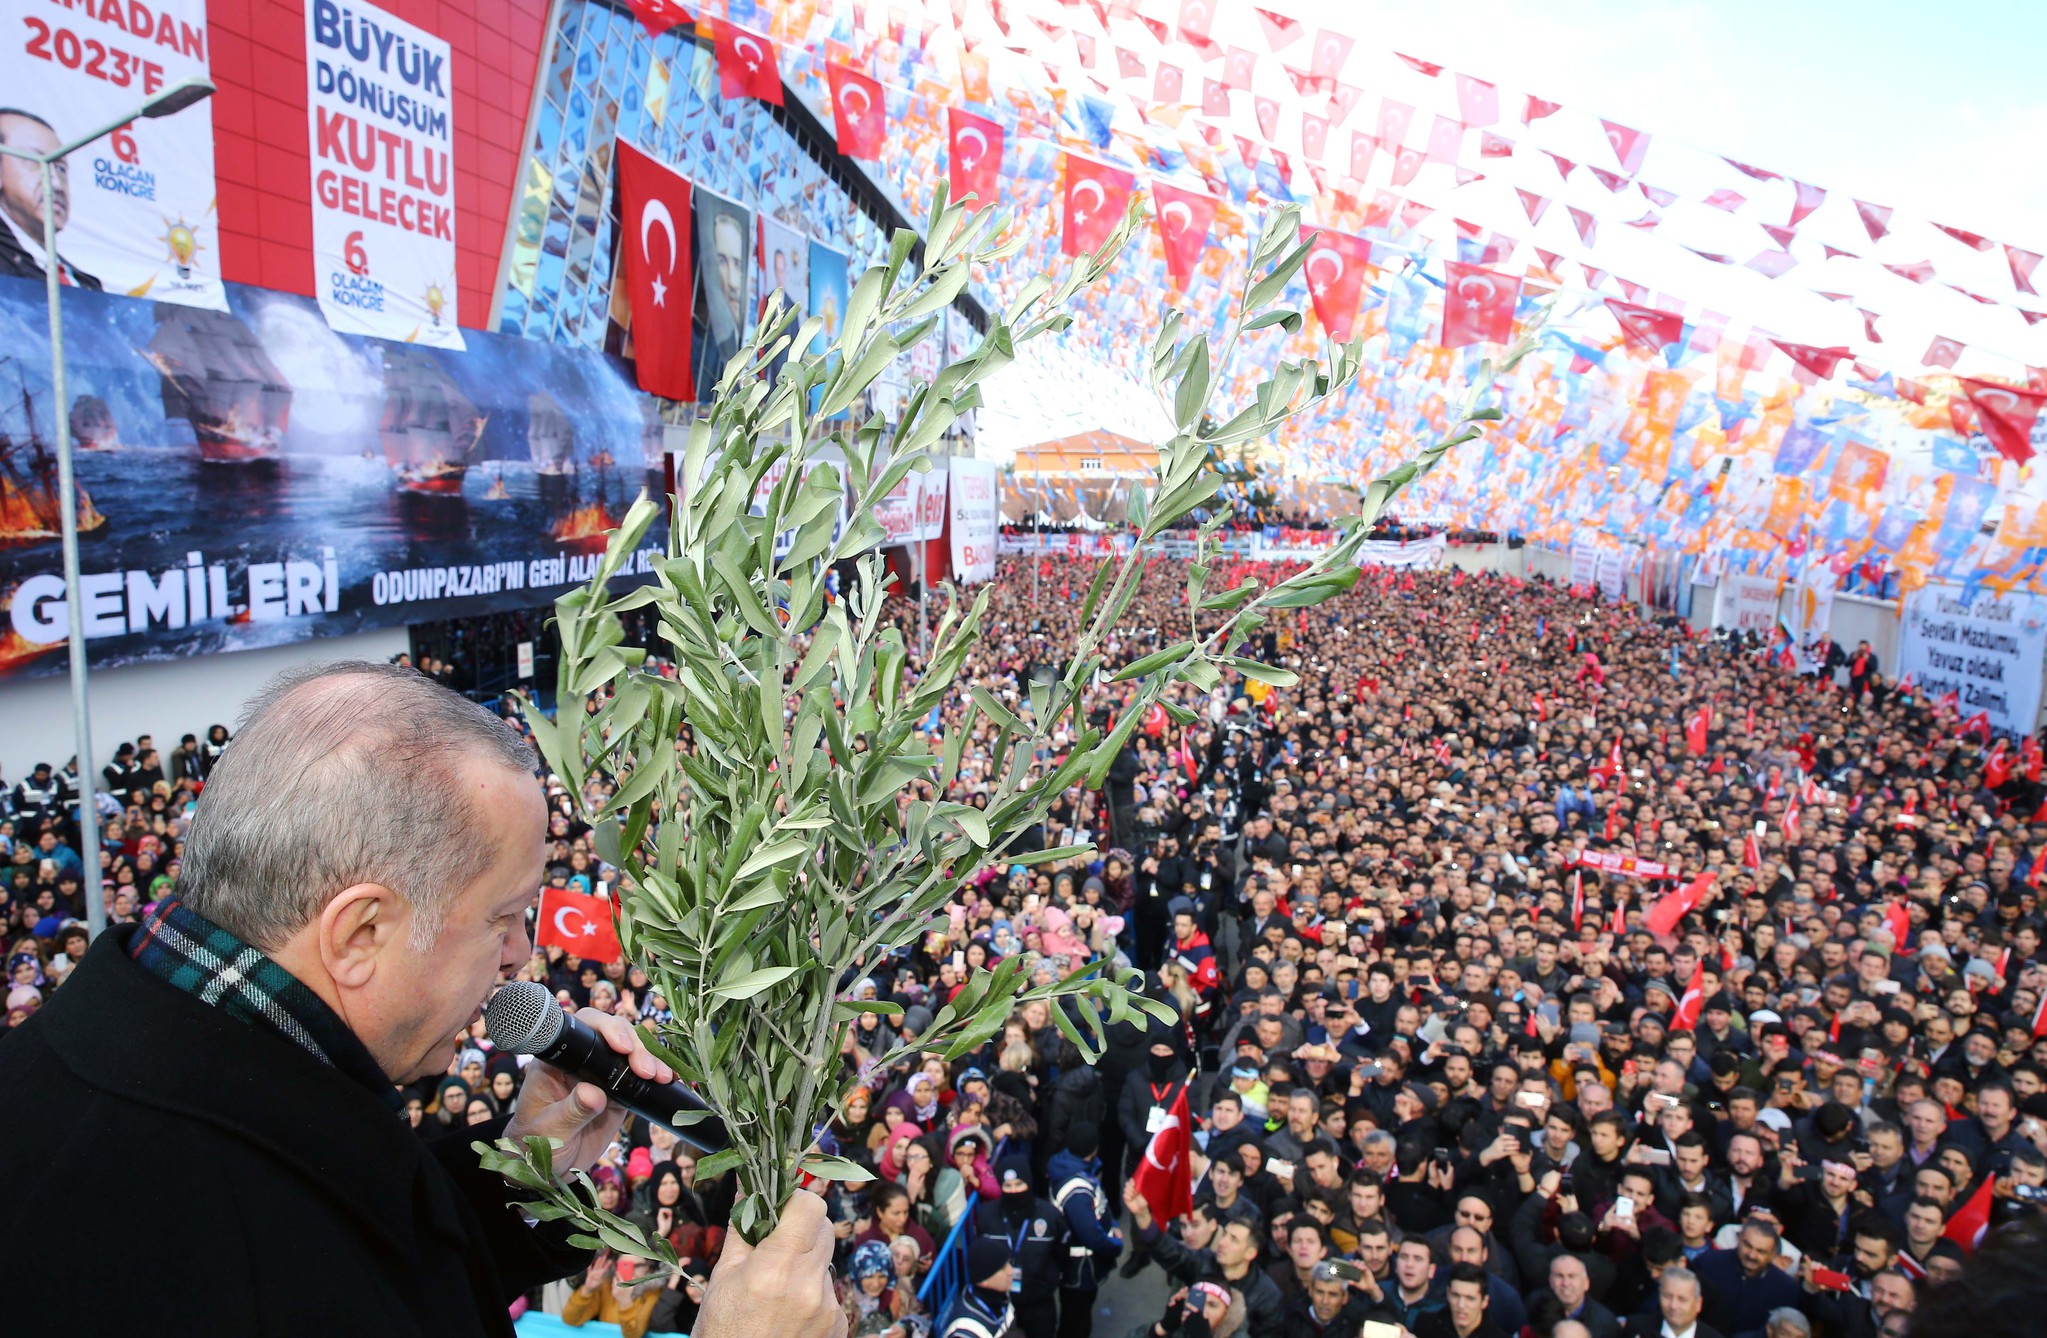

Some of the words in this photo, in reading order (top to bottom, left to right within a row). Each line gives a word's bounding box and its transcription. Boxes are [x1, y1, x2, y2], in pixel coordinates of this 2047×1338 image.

[23, 16, 163, 95] 2023'E
[50, 0, 204, 62] ADAN
[314, 0, 446, 98] BÜYÜK
[316, 58, 447, 141] DÖNÜŞÜM
[95, 173, 157, 202] KONGRE
[317, 104, 447, 197] KUTLU
[316, 169, 452, 242] GELECEK
[10, 546, 340, 645] GEMİLERİ
[372, 561, 524, 606] ODUNPAZARI'NI
[528, 551, 565, 588] GERİ
[1928, 646, 1963, 673] Yavuz
[1966, 654, 2004, 683] olduk
